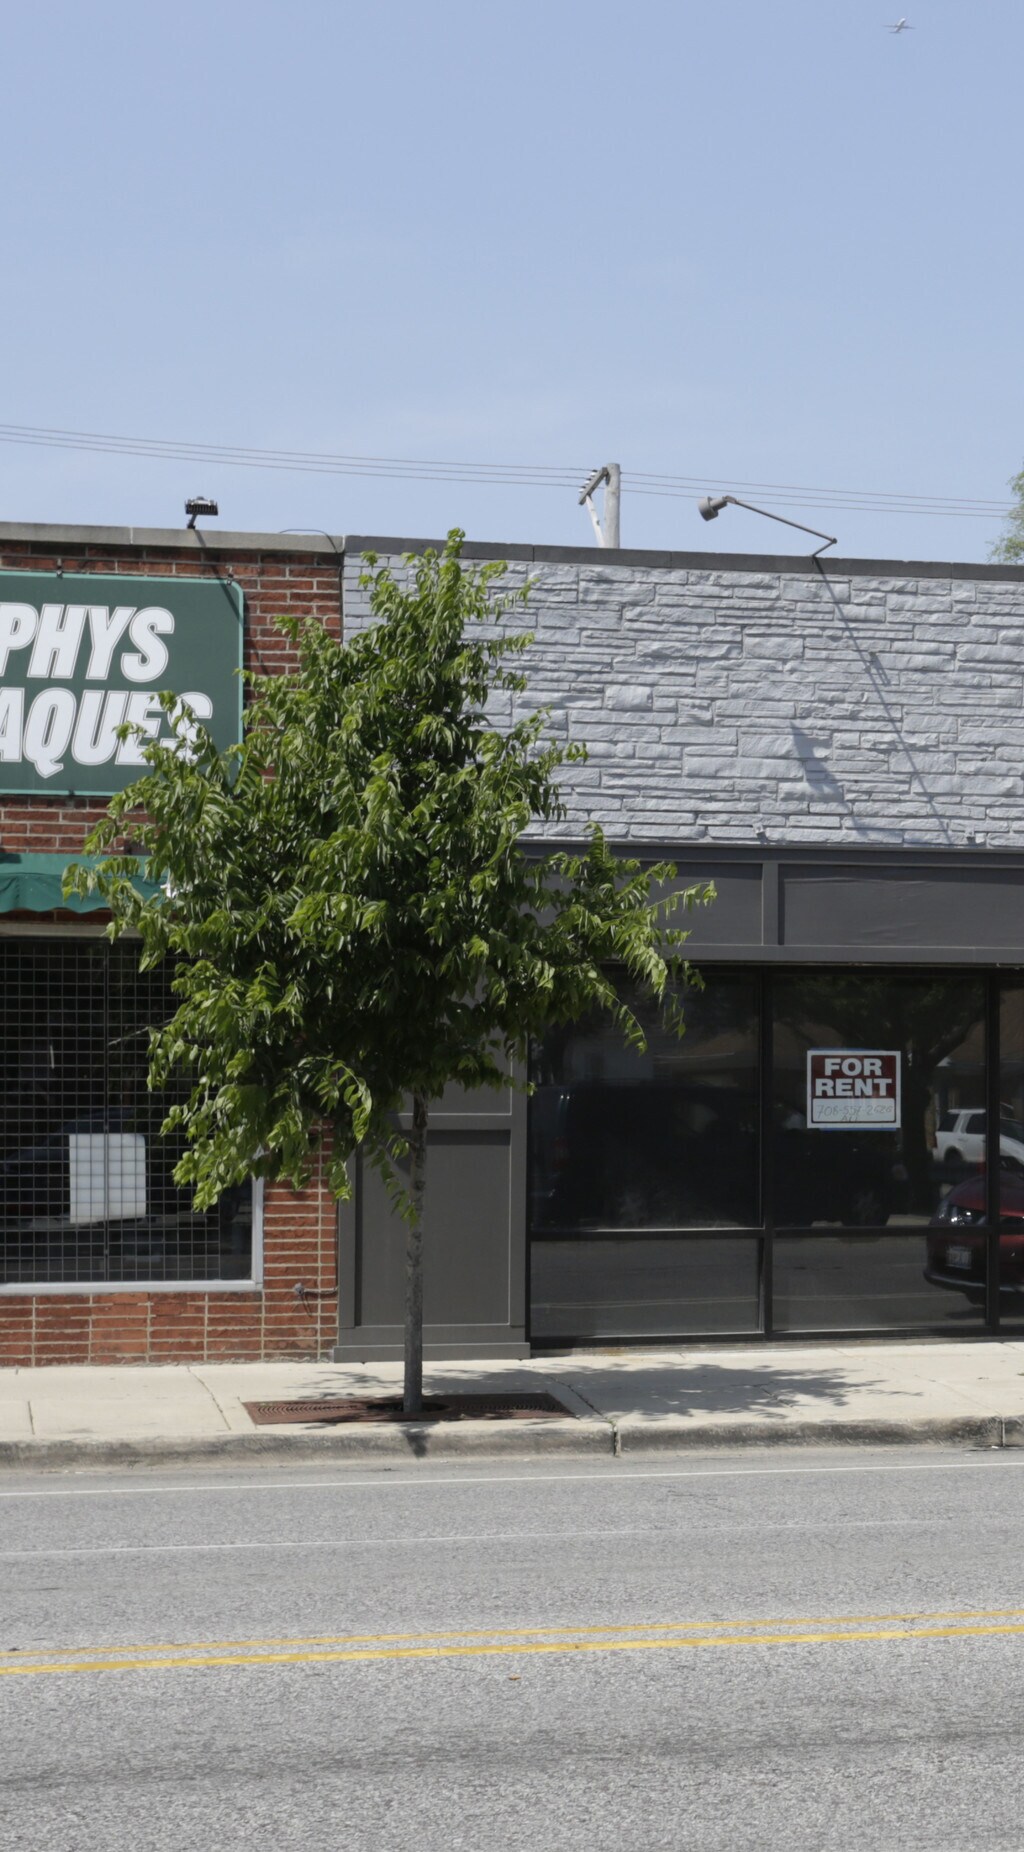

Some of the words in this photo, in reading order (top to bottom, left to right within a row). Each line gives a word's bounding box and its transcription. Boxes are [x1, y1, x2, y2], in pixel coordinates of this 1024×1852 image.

[0, 602, 175, 683] PHYS
[824, 1058, 882, 1076] FOR
[815, 1078, 892, 1096] RENT
